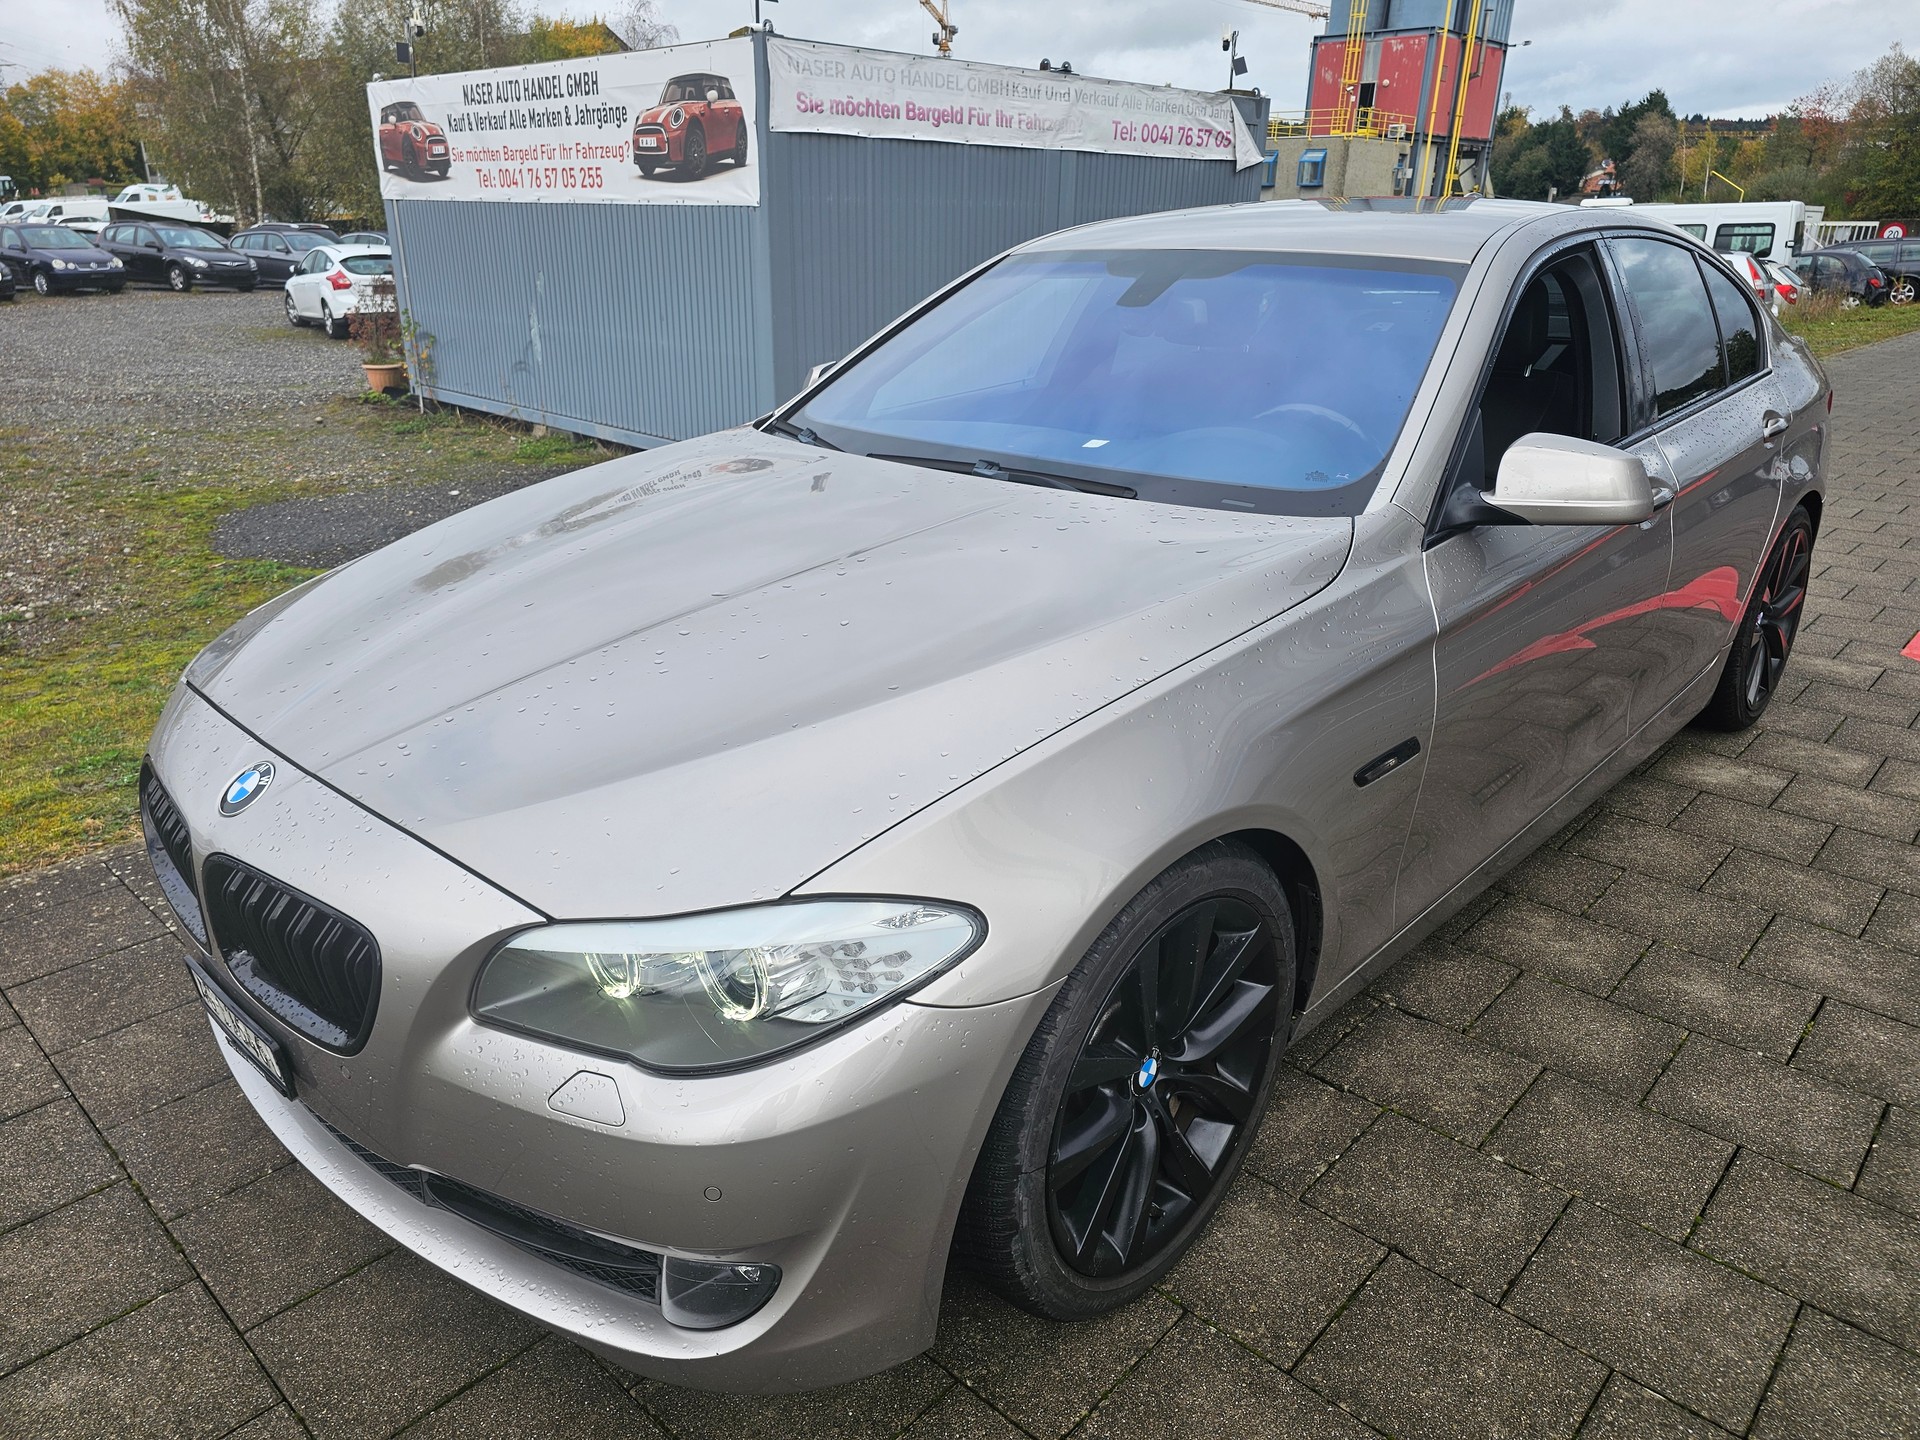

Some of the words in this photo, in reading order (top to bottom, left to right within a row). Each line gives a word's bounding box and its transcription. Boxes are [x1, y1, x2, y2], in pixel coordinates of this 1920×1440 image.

[462, 82, 494, 106] NASER
[496, 79, 521, 102] AUTO
[523, 75, 565, 101] HANDEL
[566, 71, 599, 97] GMBH
[788, 57, 845, 79] NASER
[851, 63, 896, 83] AUTO
[901, 69, 963, 91] HANDEL
[967, 76, 1009, 96] GMBH
[1012, 81, 1042, 100] Kauf
[1045, 86, 1071, 102] Und
[1074, 88, 1120, 108] Verkauf
[1121, 94, 1141, 110] Alle
[1145, 98, 1184, 114] Marken
[1186, 102, 1206, 117] Und
[447, 113, 467, 132] Kauf
[468, 115, 473, 131] &
[473, 109, 508, 132] Verkauf
[509, 109, 527, 130] Alle
[528, 106, 563, 129] Marken
[564, 105, 572, 126] &
[574, 102, 628, 129] Jahrgänge
[796, 91, 824, 114] Sie
[829, 95, 900, 120] möchten
[906, 101, 963, 128] Bargeld
[967, 106, 991, 127] Für
[995, 109, 1014, 128] Ihr
[1017, 112, 1083, 133] Fahrze?
[1112, 120, 1137, 142] Tel:
[1141, 123, 1173, 145] 0041
[1178, 126, 1193, 146] 76
[1196, 127, 1213, 147] 57
[1215, 130, 1232, 148] 05
[452, 147, 464, 162] Sie
[466, 145, 501, 162] möchten
[503, 144, 538, 165] Bargeld
[541, 142, 557, 160] Für
[559, 143, 573, 160] Ihr
[576, 140, 631, 163] Fahrzeug?
[476, 168, 496, 188] Tel:
[498, 168, 525, 188] 0041
[528, 168, 541, 188] 76
[545, 168, 558, 188] 57
[562, 167, 577, 188] 05
[581, 167, 603, 188] 255
[1887, 230, 1899, 239] 20
